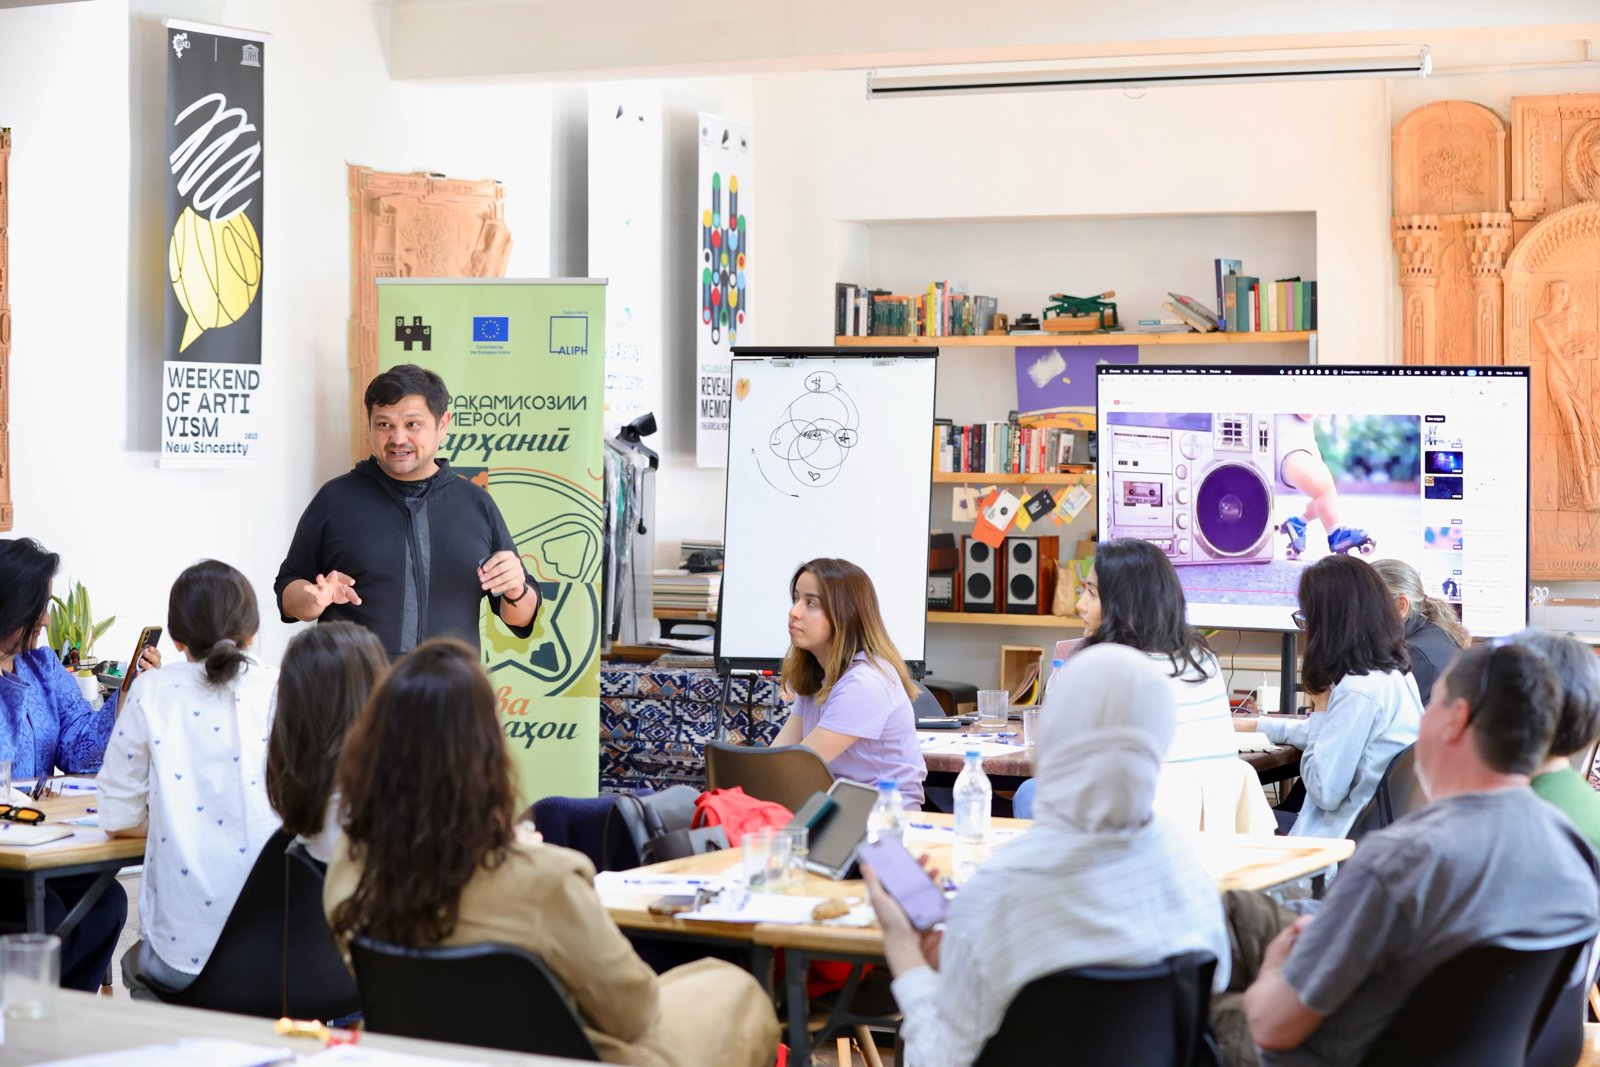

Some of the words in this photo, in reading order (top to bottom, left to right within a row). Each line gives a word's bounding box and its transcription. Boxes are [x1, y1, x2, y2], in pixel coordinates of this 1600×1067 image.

[558, 346, 588, 354] ALIPH
[168, 367, 260, 390] WEEKEND
[166, 392, 190, 412] OF
[197, 392, 250, 414] ARTI
[702, 399, 730, 418] MEMO
[166, 416, 218, 437] VISM
[166, 441, 191, 453] New
[194, 442, 248, 456] Sincerity
